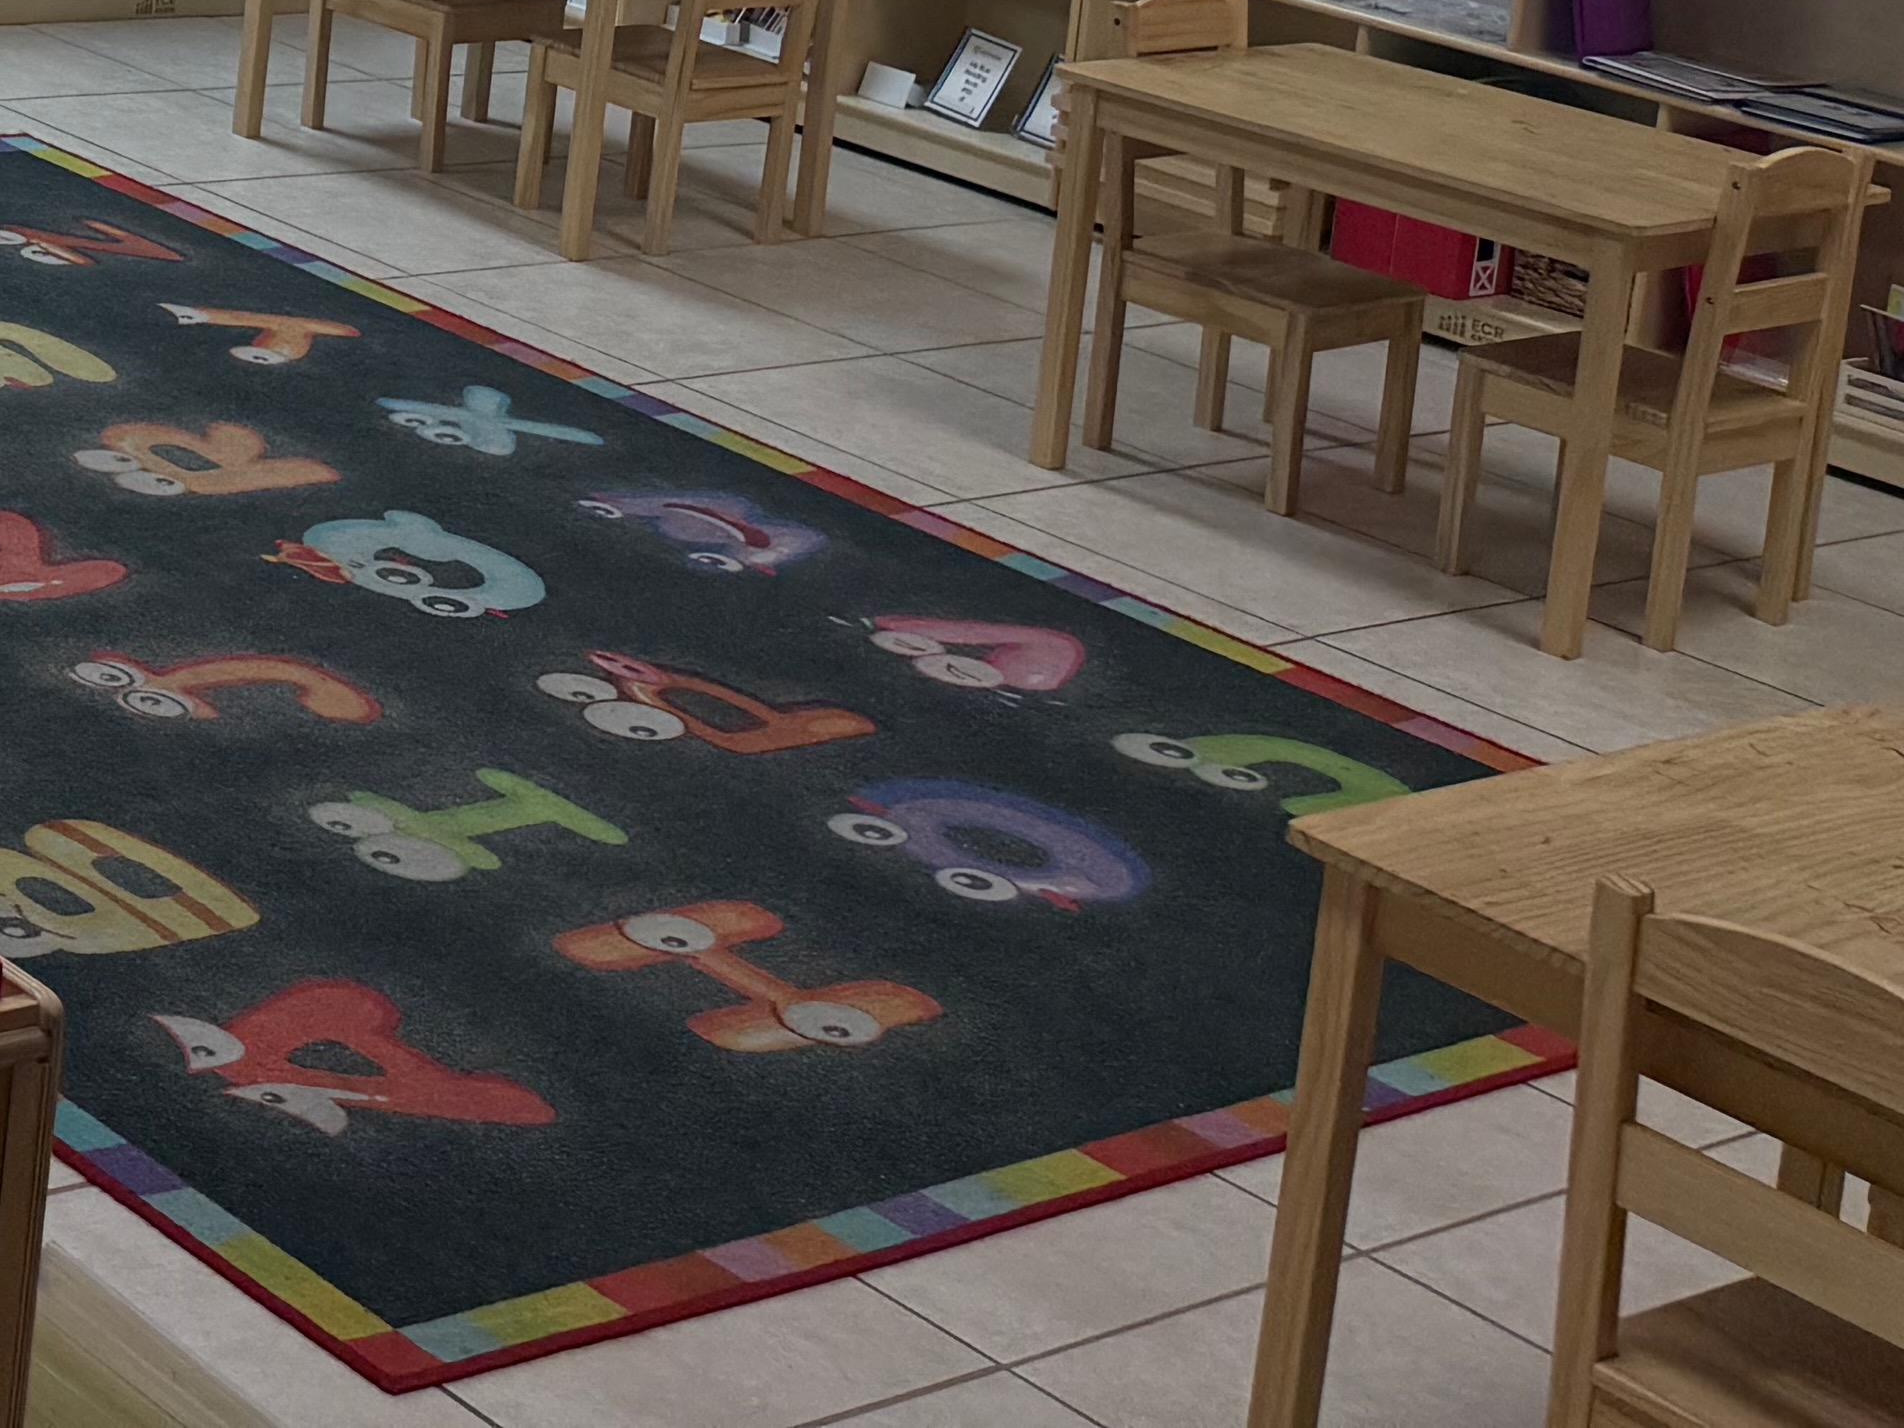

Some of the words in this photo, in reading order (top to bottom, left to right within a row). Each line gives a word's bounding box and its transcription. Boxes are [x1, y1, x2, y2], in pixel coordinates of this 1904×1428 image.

[156, 301, 361, 365] Y
[1472, 319, 1505, 339] ECR
[375, 385, 605, 457] X
[70, 420, 343, 497] R
[553, 898, 944, 1055] H
[150, 977, 556, 1139] A
